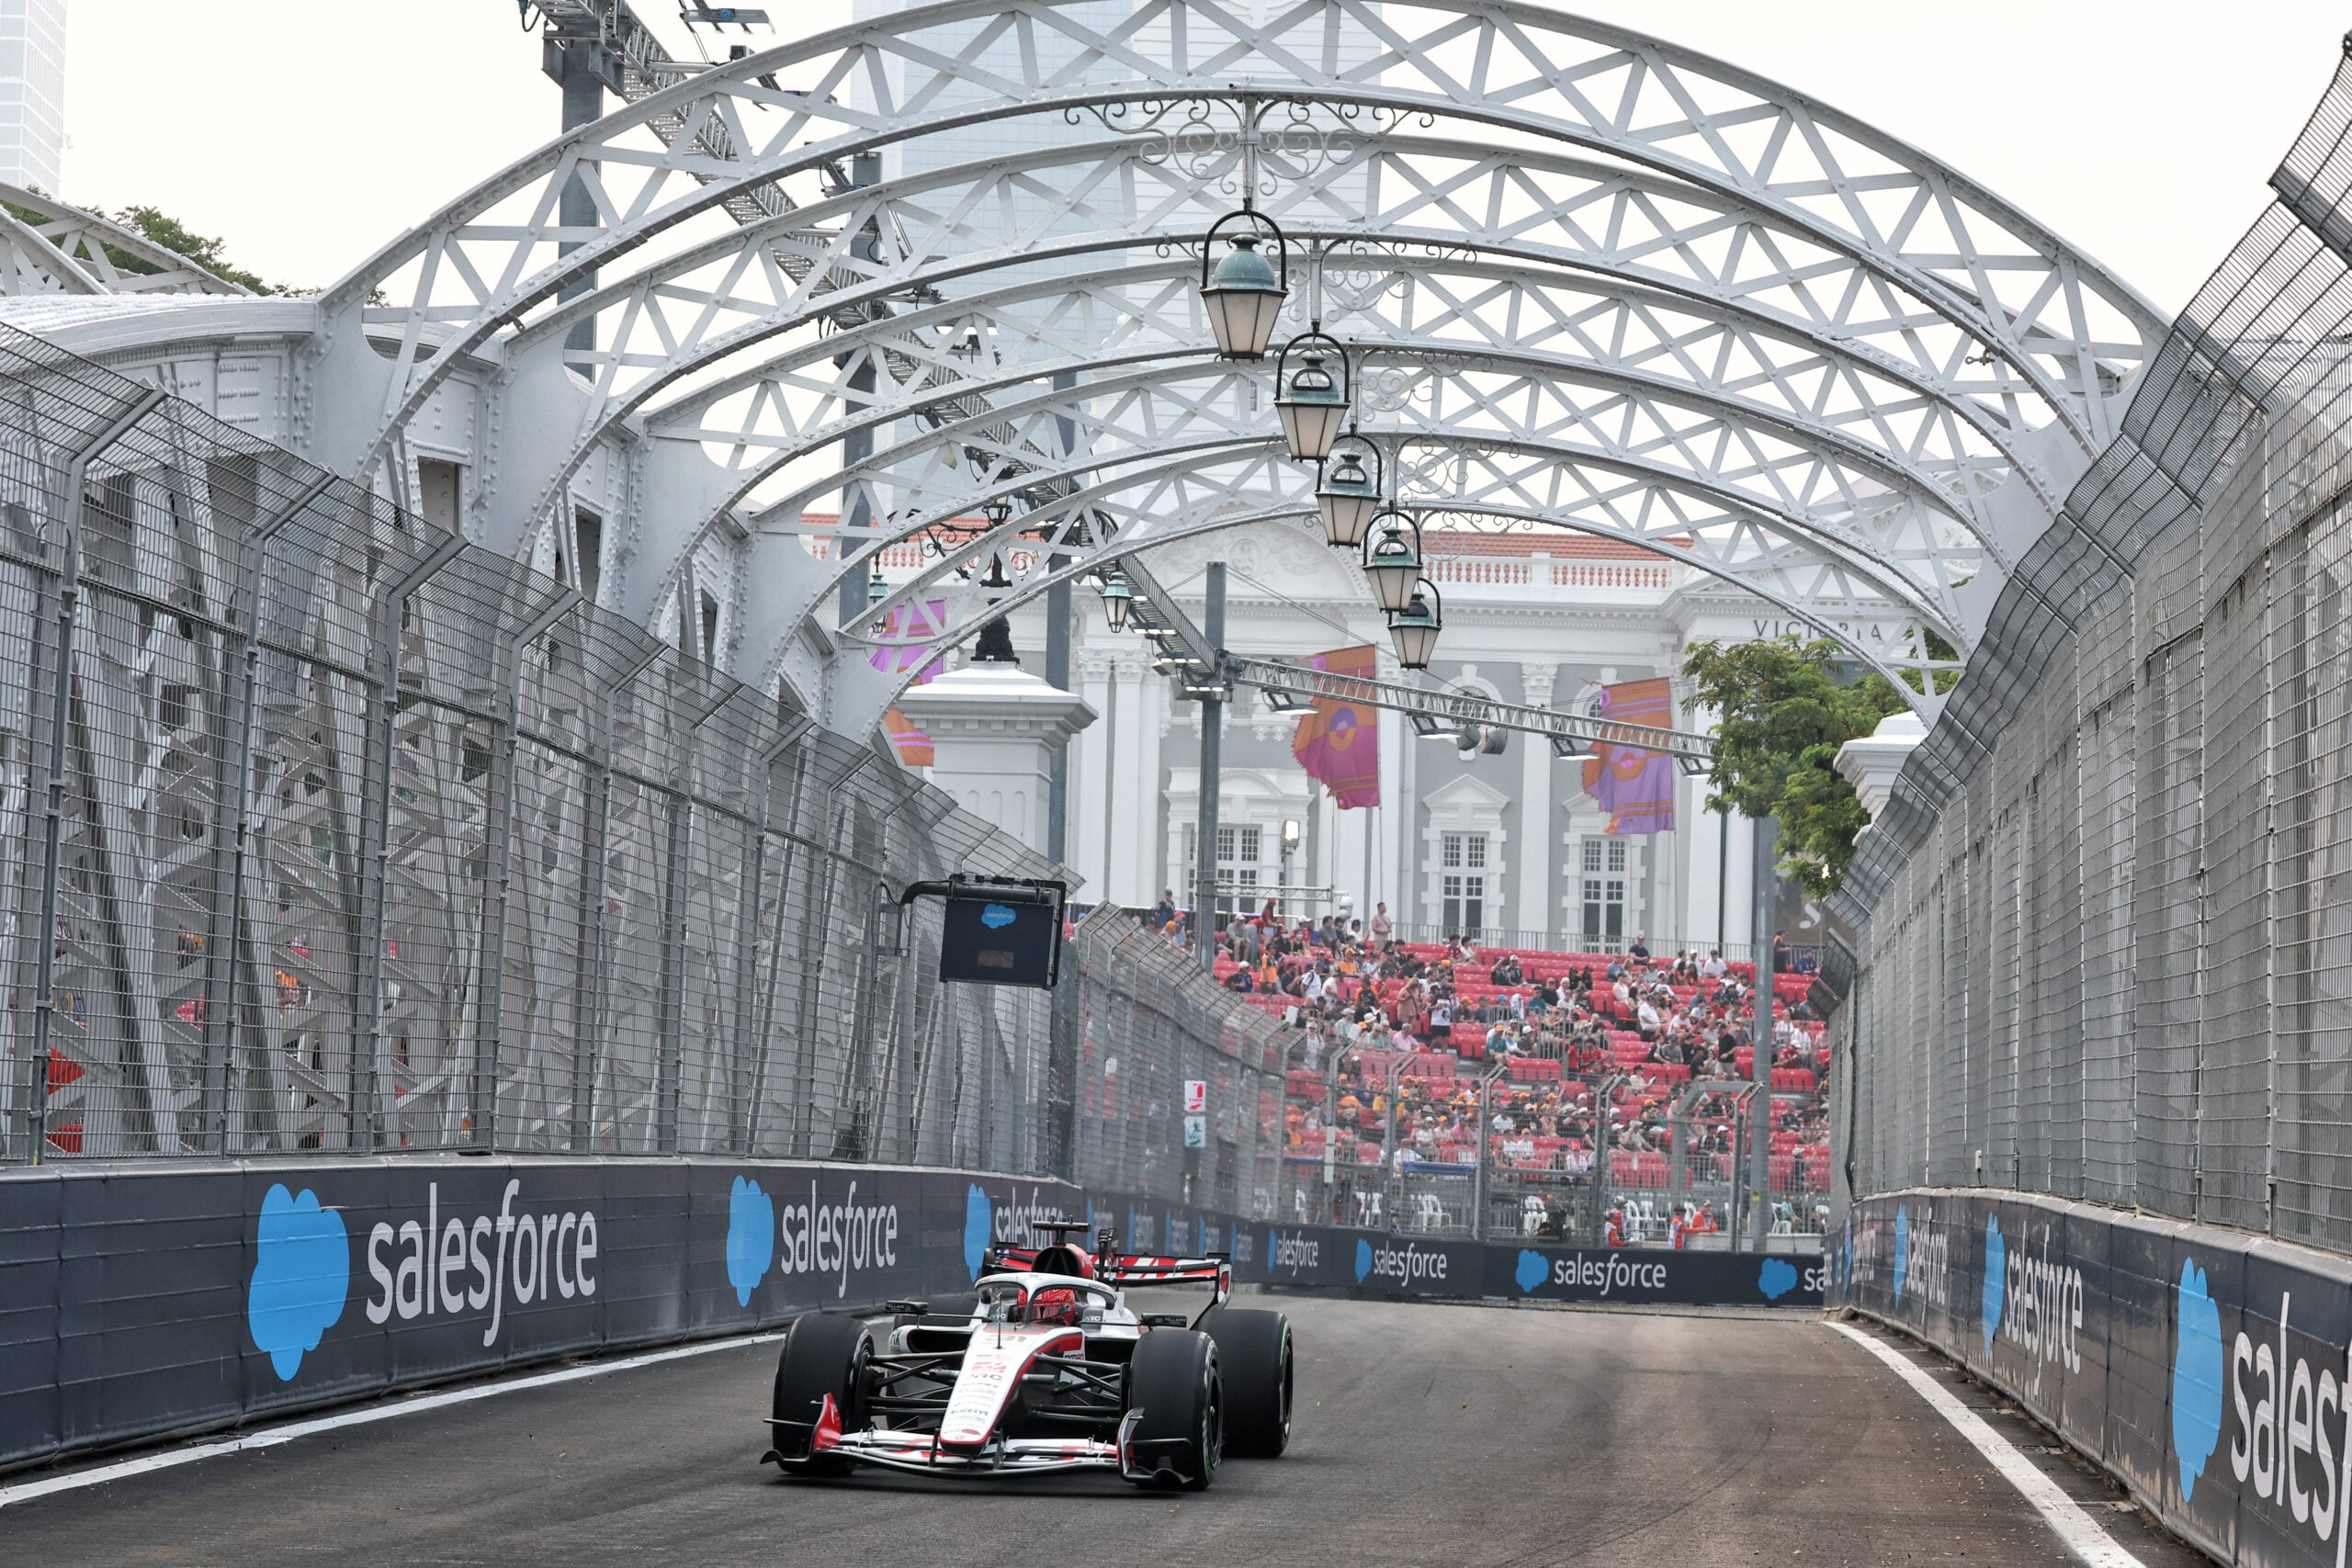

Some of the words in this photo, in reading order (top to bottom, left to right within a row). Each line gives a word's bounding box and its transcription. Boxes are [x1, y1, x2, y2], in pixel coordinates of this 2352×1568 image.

[367, 1178, 597, 1347] salesforce
[781, 1179, 898, 1299] salesforce
[1374, 1242, 1447, 1287] salesforce
[1554, 1252, 1667, 1296] salesforce
[2005, 1220, 2083, 1396] salesforce
